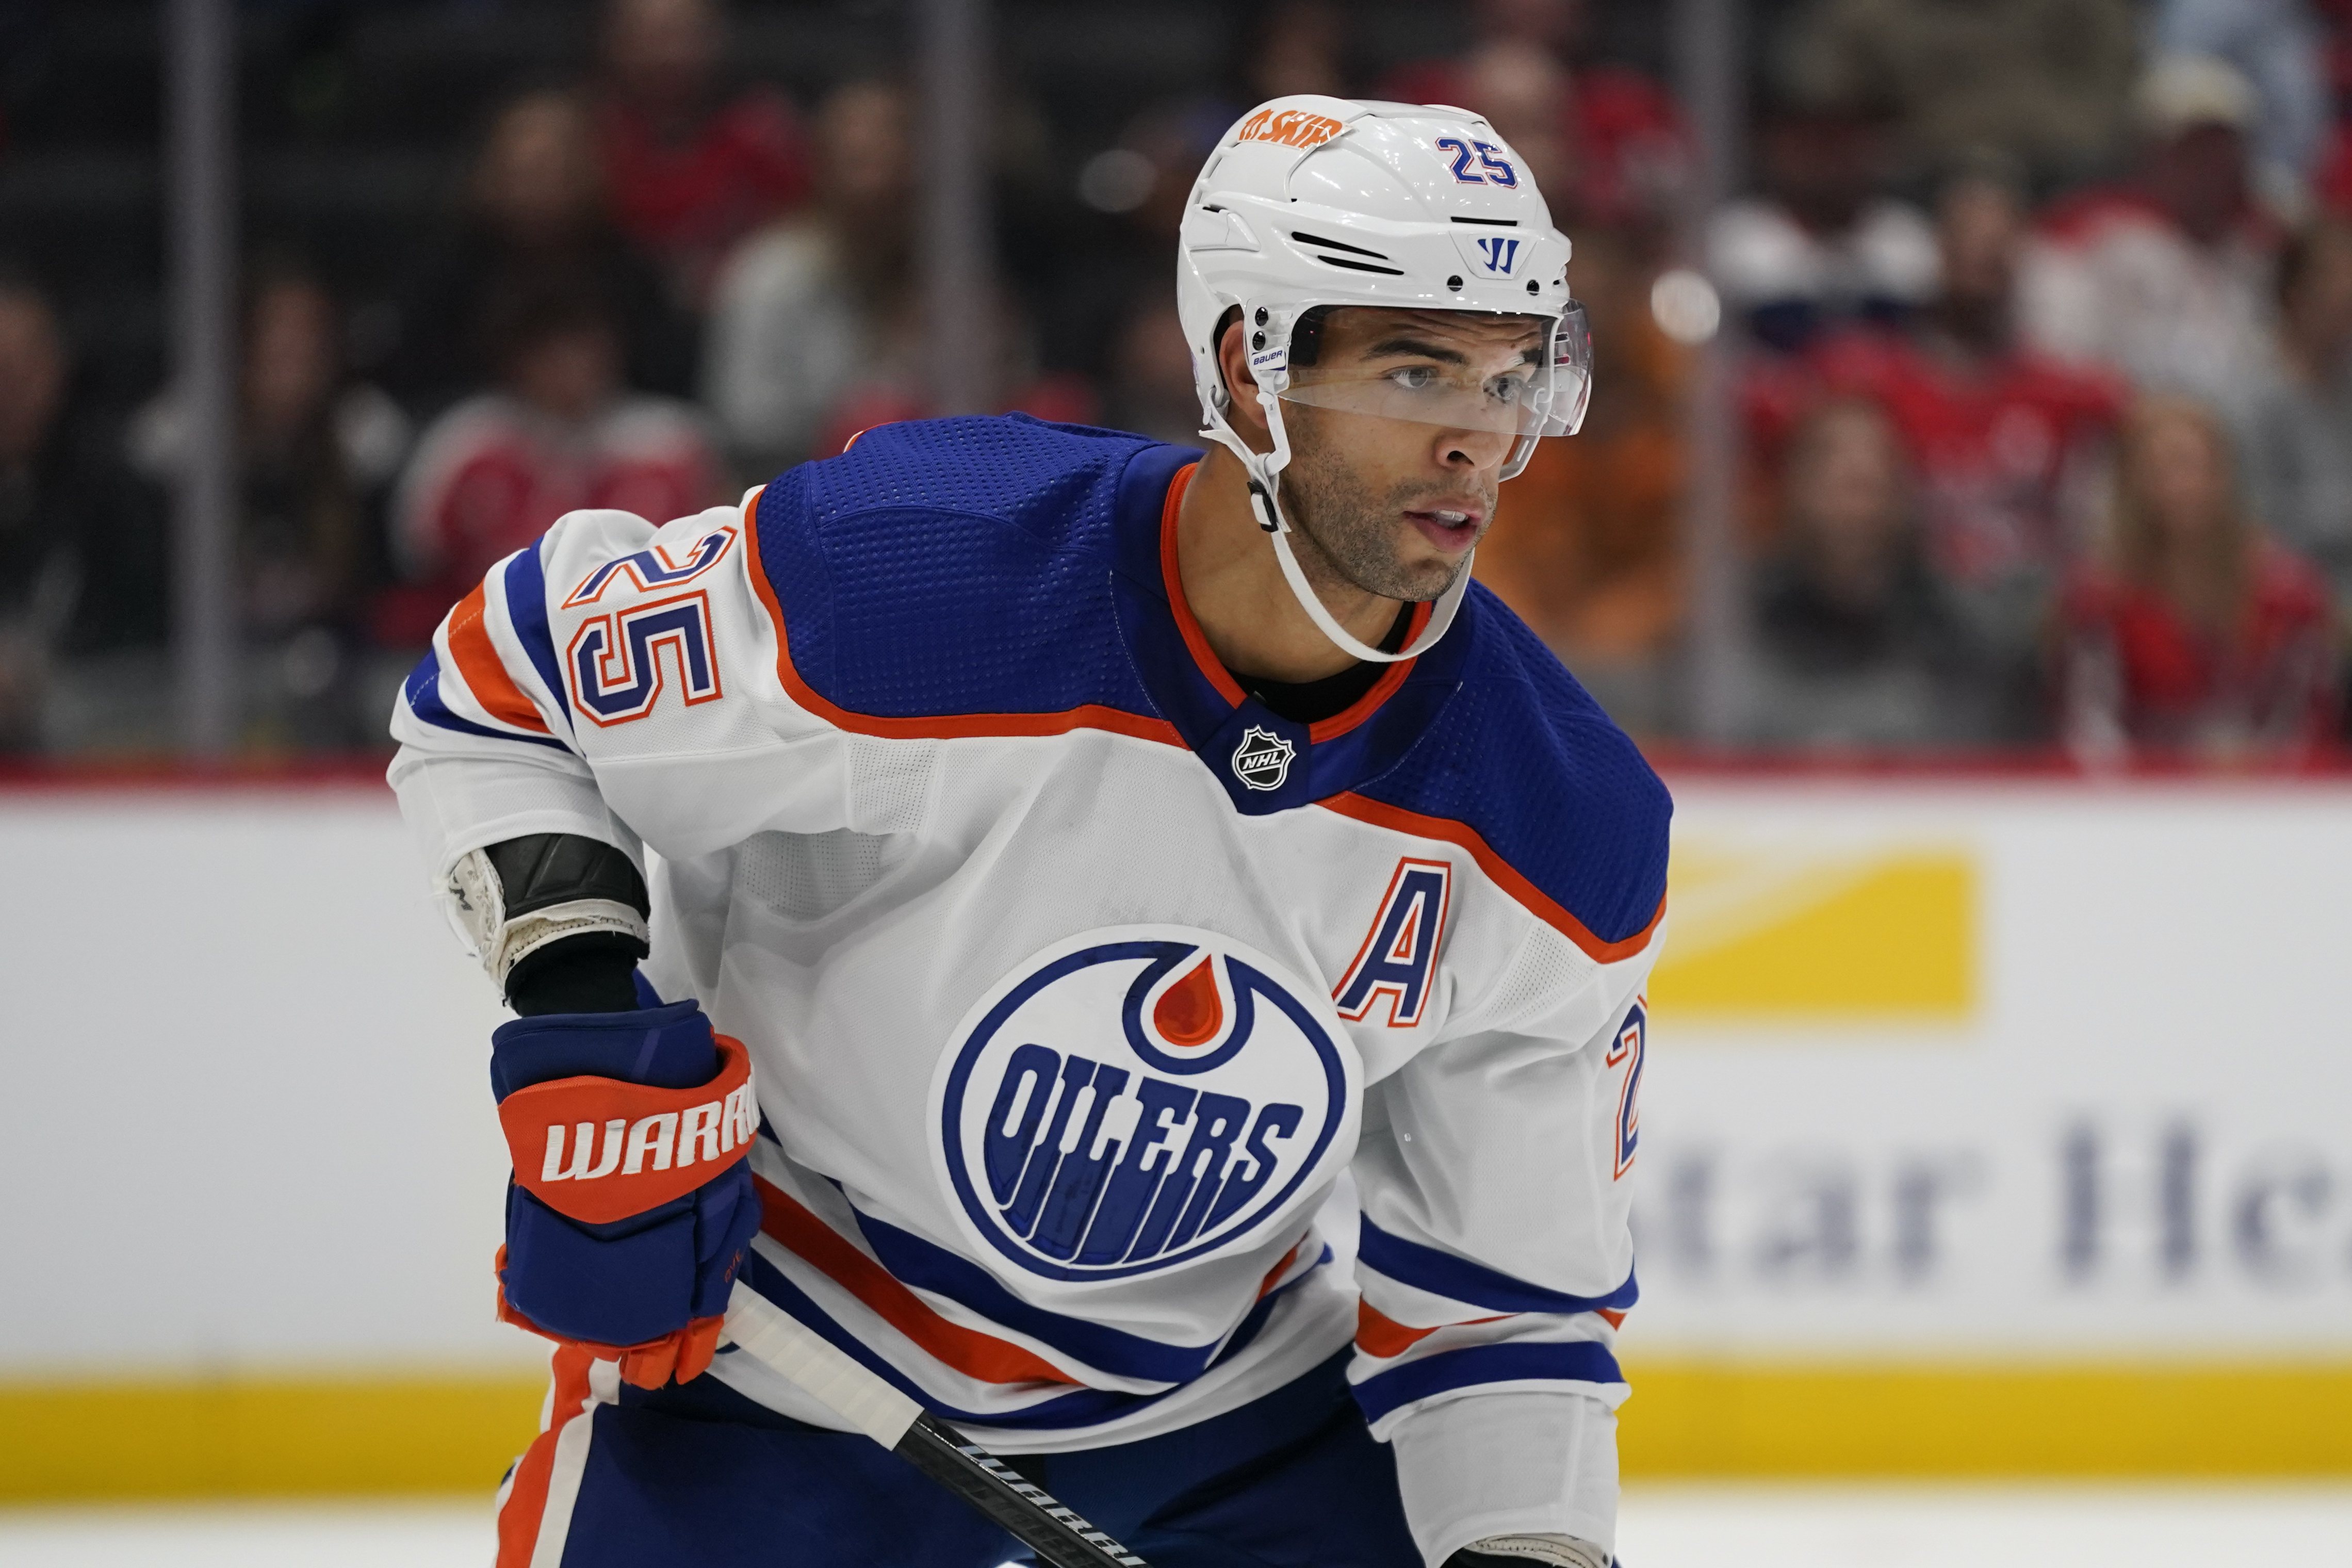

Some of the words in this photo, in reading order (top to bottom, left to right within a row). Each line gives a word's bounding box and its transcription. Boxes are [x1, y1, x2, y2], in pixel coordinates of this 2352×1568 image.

[1435, 137, 1518, 189] 25
[561, 525, 738, 728] 25
[1242, 752, 1281, 770] NHL
[1331, 856, 1451, 1028] A
[984, 1043, 1304, 1265] OILERS
[2050, 1106, 2352, 1287] He
